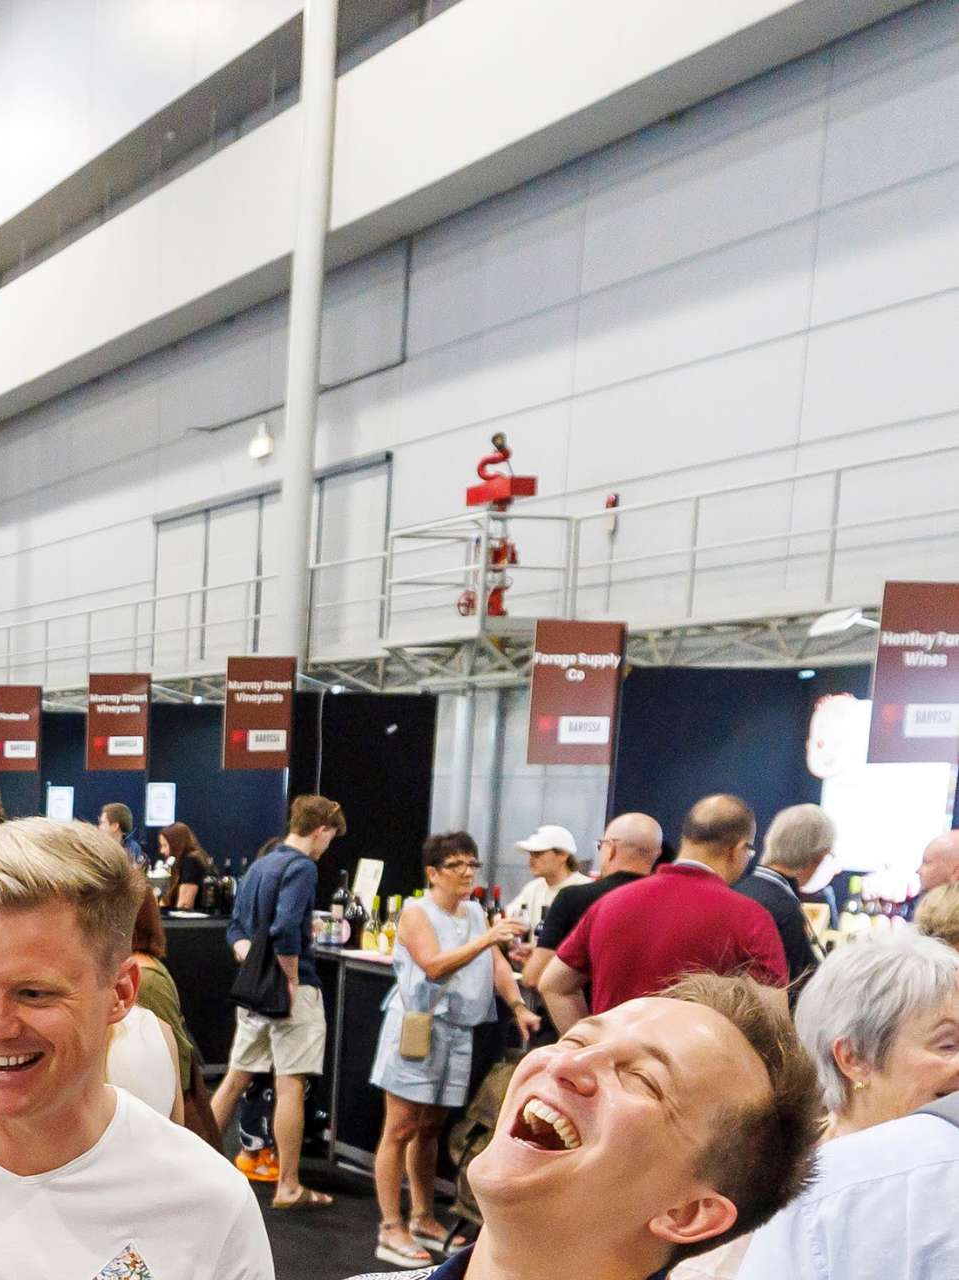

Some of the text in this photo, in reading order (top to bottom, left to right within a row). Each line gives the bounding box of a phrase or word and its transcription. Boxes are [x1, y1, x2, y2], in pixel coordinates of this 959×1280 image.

[882, 630, 935, 651] Hentley
[578, 652, 621, 669] Supply
[904, 651, 947, 667] Wines
[235, 692, 284, 705] Vineyards
